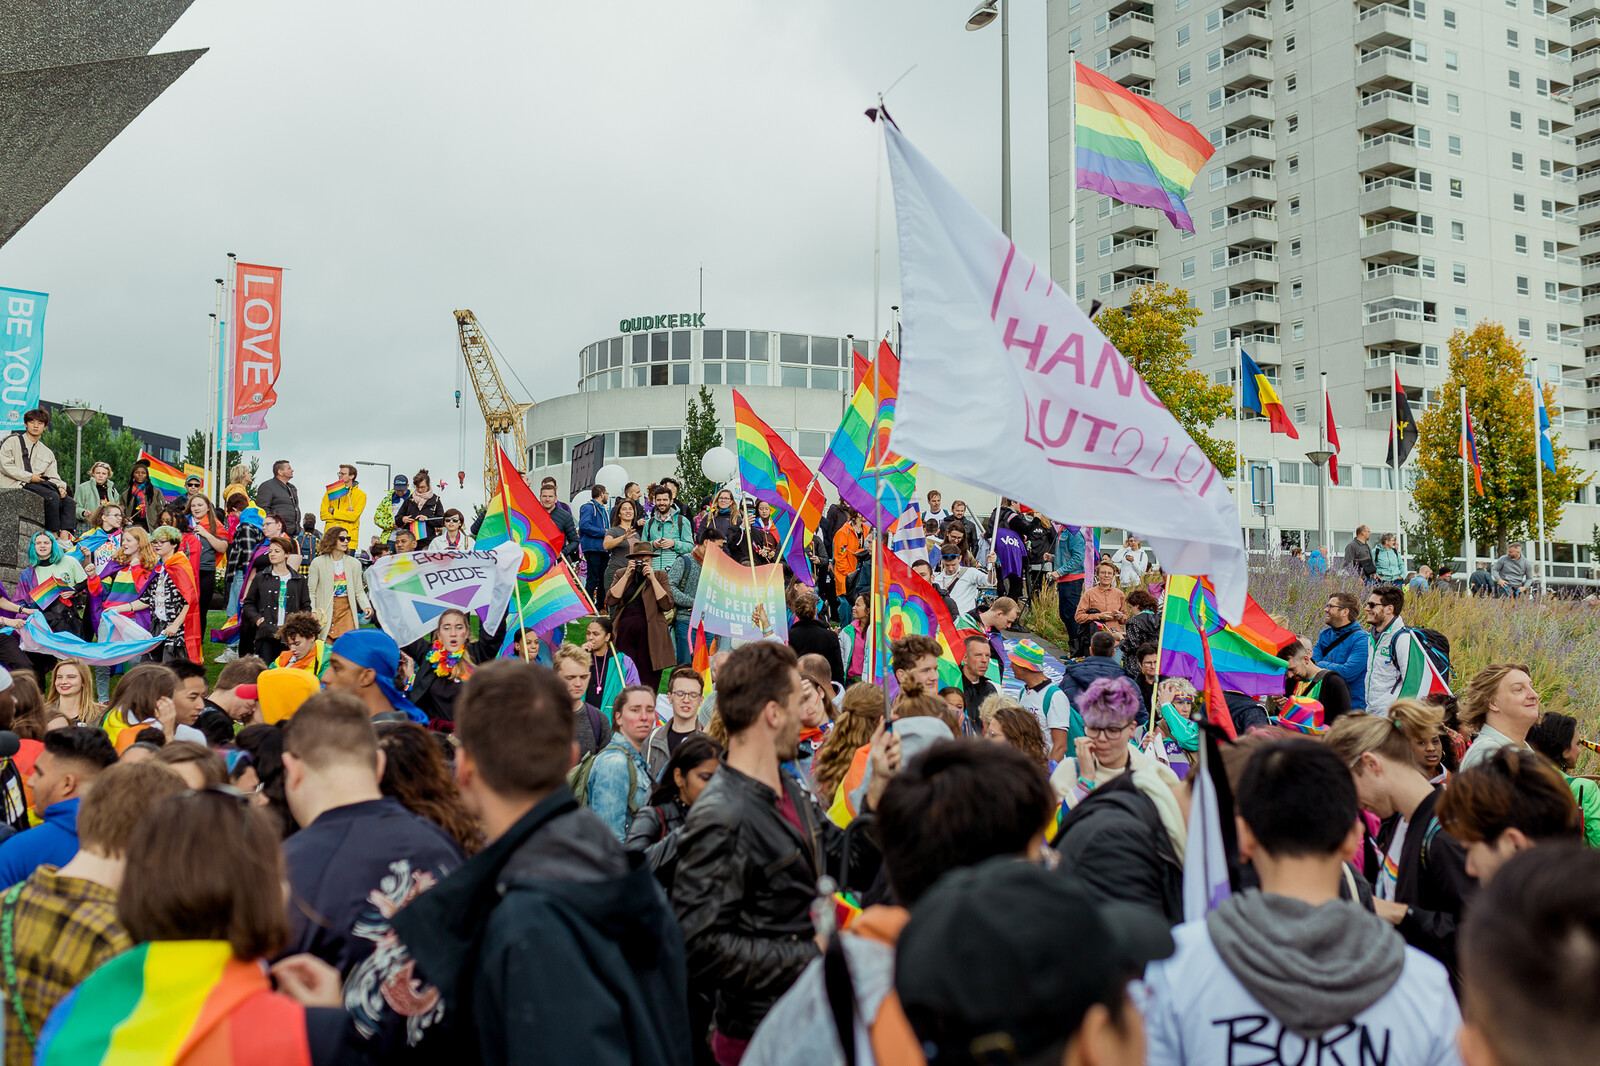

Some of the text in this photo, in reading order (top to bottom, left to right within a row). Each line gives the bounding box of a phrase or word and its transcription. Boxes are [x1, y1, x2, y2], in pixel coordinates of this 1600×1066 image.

[6, 296, 34, 338] BE
[243, 274, 275, 387] LOVE
[620, 312, 706, 333] OUDKERK
[2, 346, 31, 407] YOU
[424, 566, 488, 590] PRIDE
[706, 585, 776, 614] DE PETIIE
[1212, 1014, 1391, 1066] BORN
